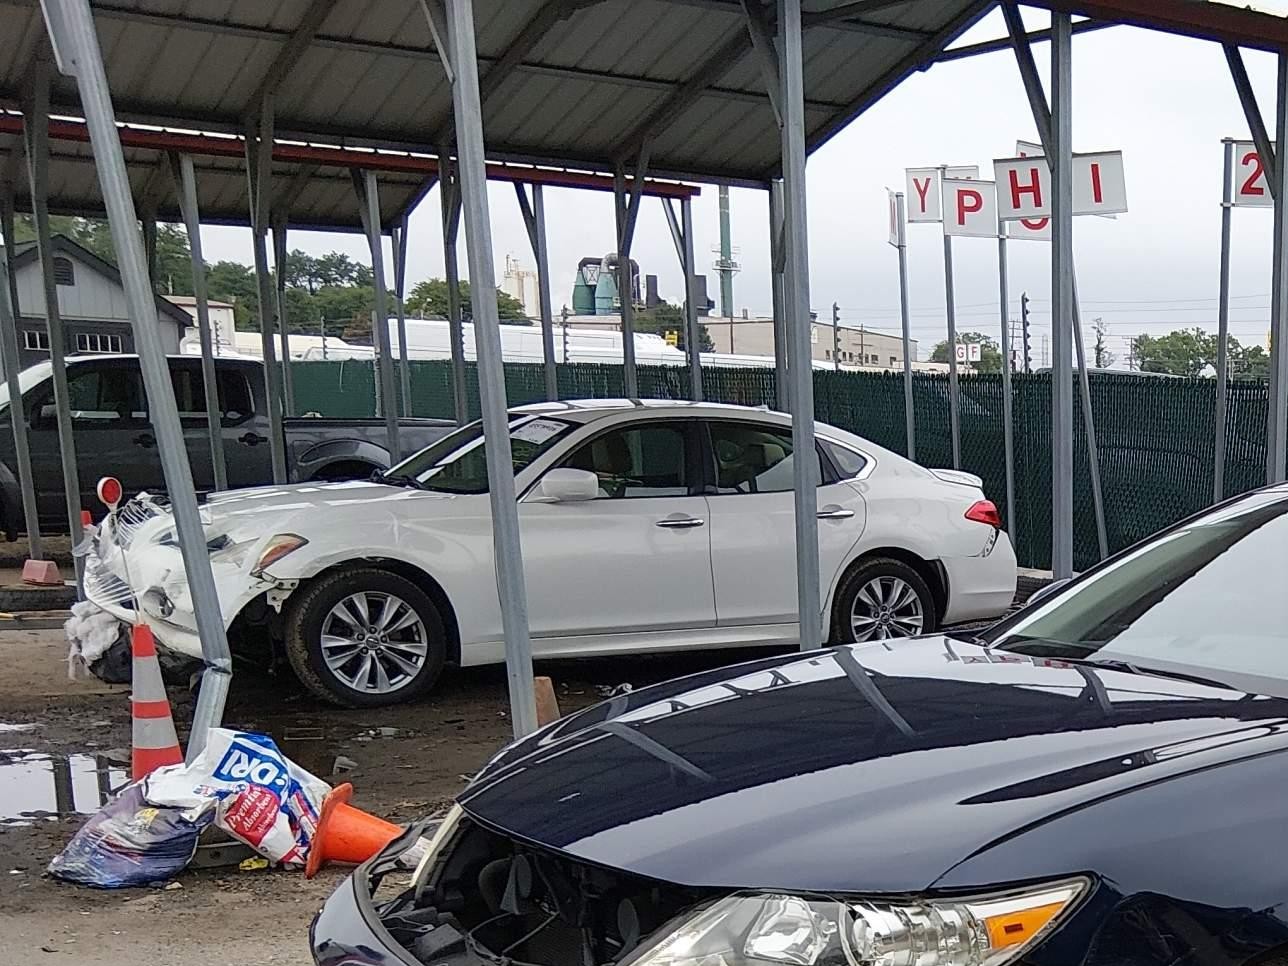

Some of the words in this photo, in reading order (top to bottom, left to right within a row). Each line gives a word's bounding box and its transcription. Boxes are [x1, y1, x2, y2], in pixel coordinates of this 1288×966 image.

[912, 177, 932, 213] Y
[1008, 168, 1043, 209] H
[1090, 163, 1103, 203] I
[956, 189, 984, 226] P
